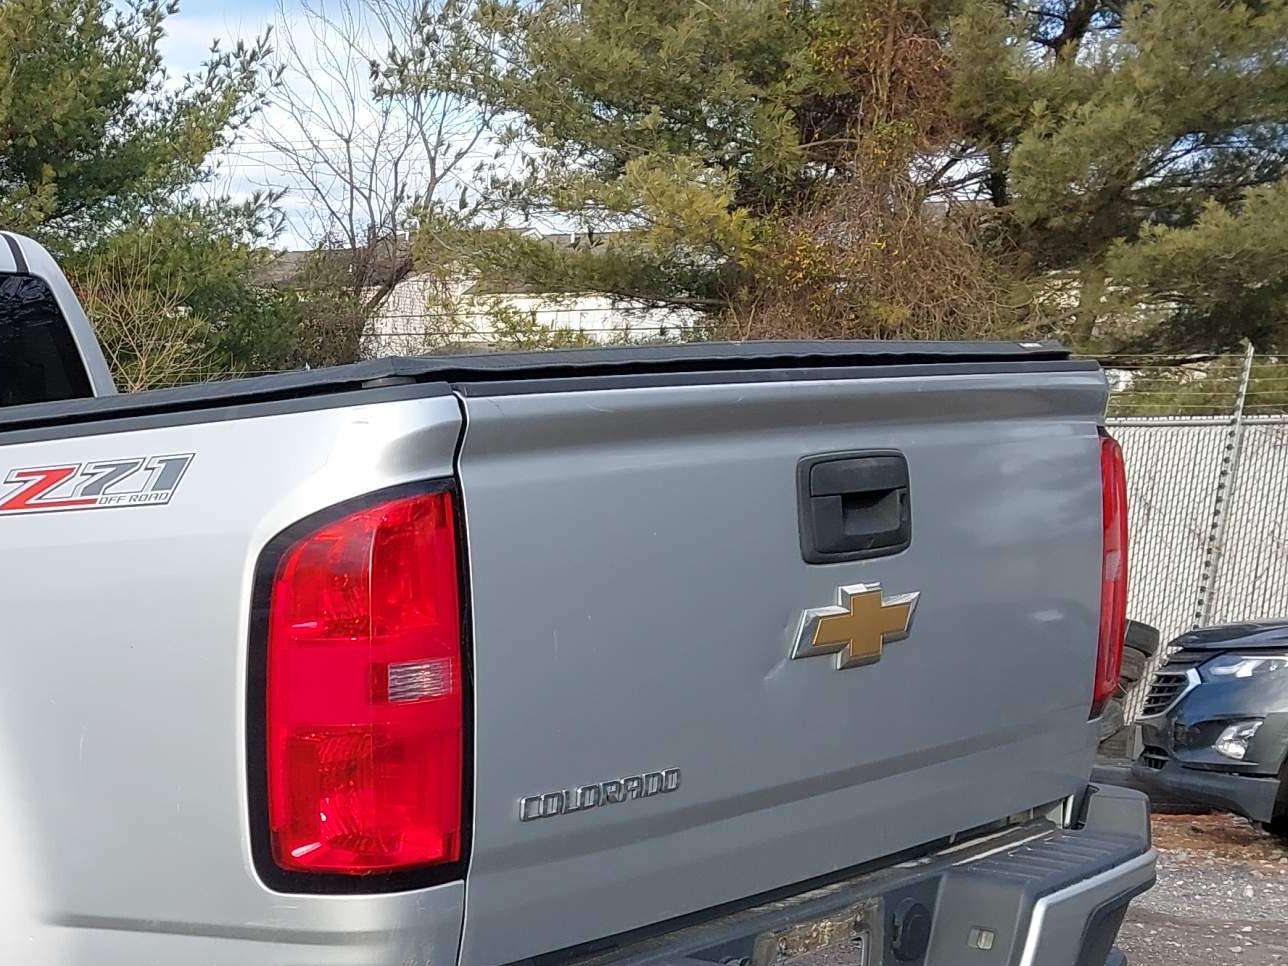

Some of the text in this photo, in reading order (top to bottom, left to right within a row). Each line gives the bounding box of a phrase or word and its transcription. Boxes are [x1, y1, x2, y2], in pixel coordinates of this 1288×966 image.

[98, 492, 169, 505] OFF ROAD
[519, 767, 681, 822] COLORADO
